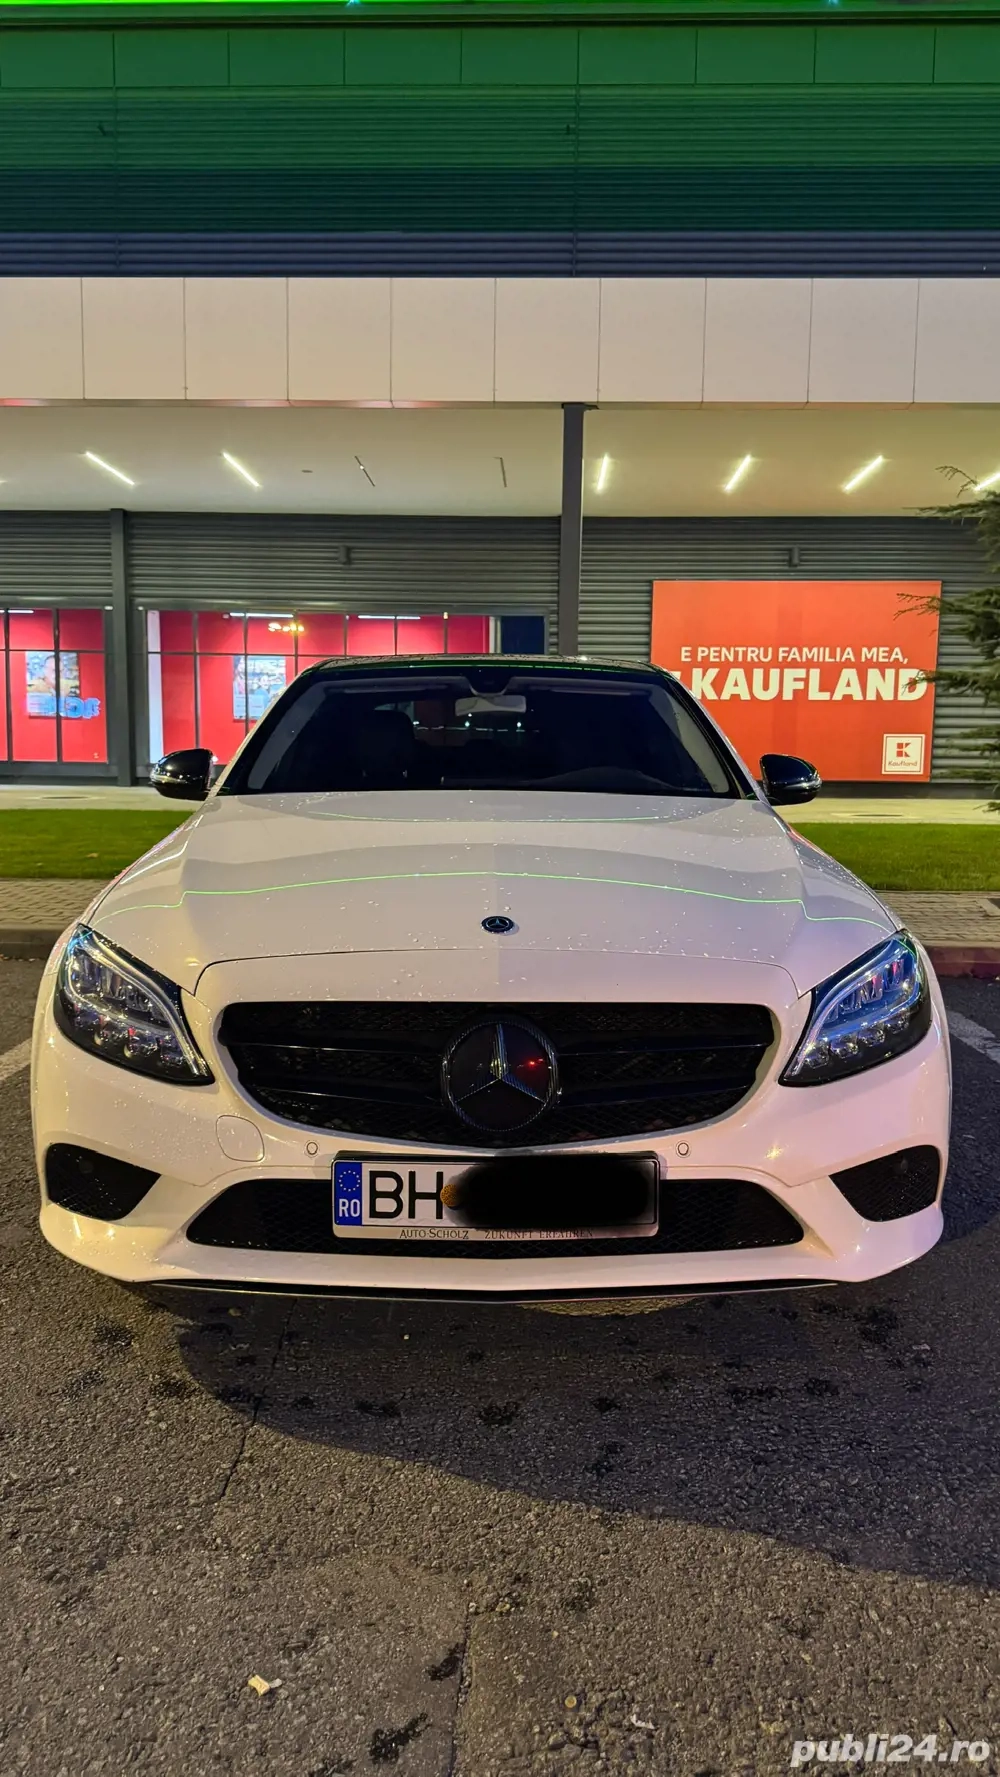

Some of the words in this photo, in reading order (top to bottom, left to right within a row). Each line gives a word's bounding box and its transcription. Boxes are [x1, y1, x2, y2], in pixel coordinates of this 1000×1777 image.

[681, 647, 692, 662] E
[697, 647, 772, 662] PENTRU
[778, 647, 855, 662] FAMILIA
[861, 647, 908, 664] MEA,
[690, 668, 928, 701] KAUFLAND
[338, 1198, 361, 1217] RO
[484, 1230, 533, 1239] ZUKUNFT
[539, 1229, 594, 1239] ERFAHREN
